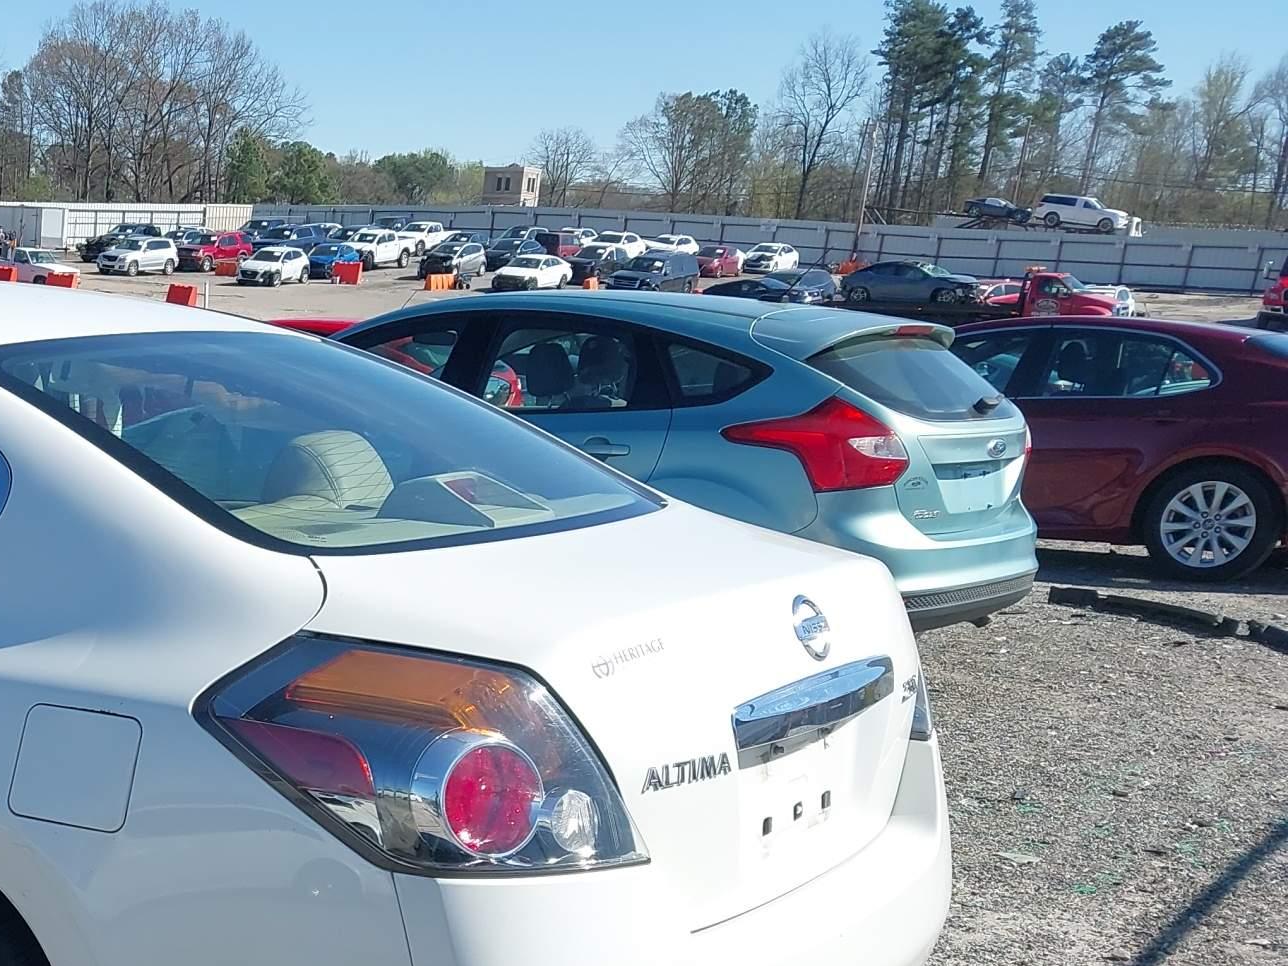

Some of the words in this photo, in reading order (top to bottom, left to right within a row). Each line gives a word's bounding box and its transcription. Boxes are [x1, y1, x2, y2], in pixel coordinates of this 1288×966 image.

[801, 620, 827, 635] NISS
[613, 638, 665, 664] HERITAGE
[640, 752, 732, 795] ALTIMA
